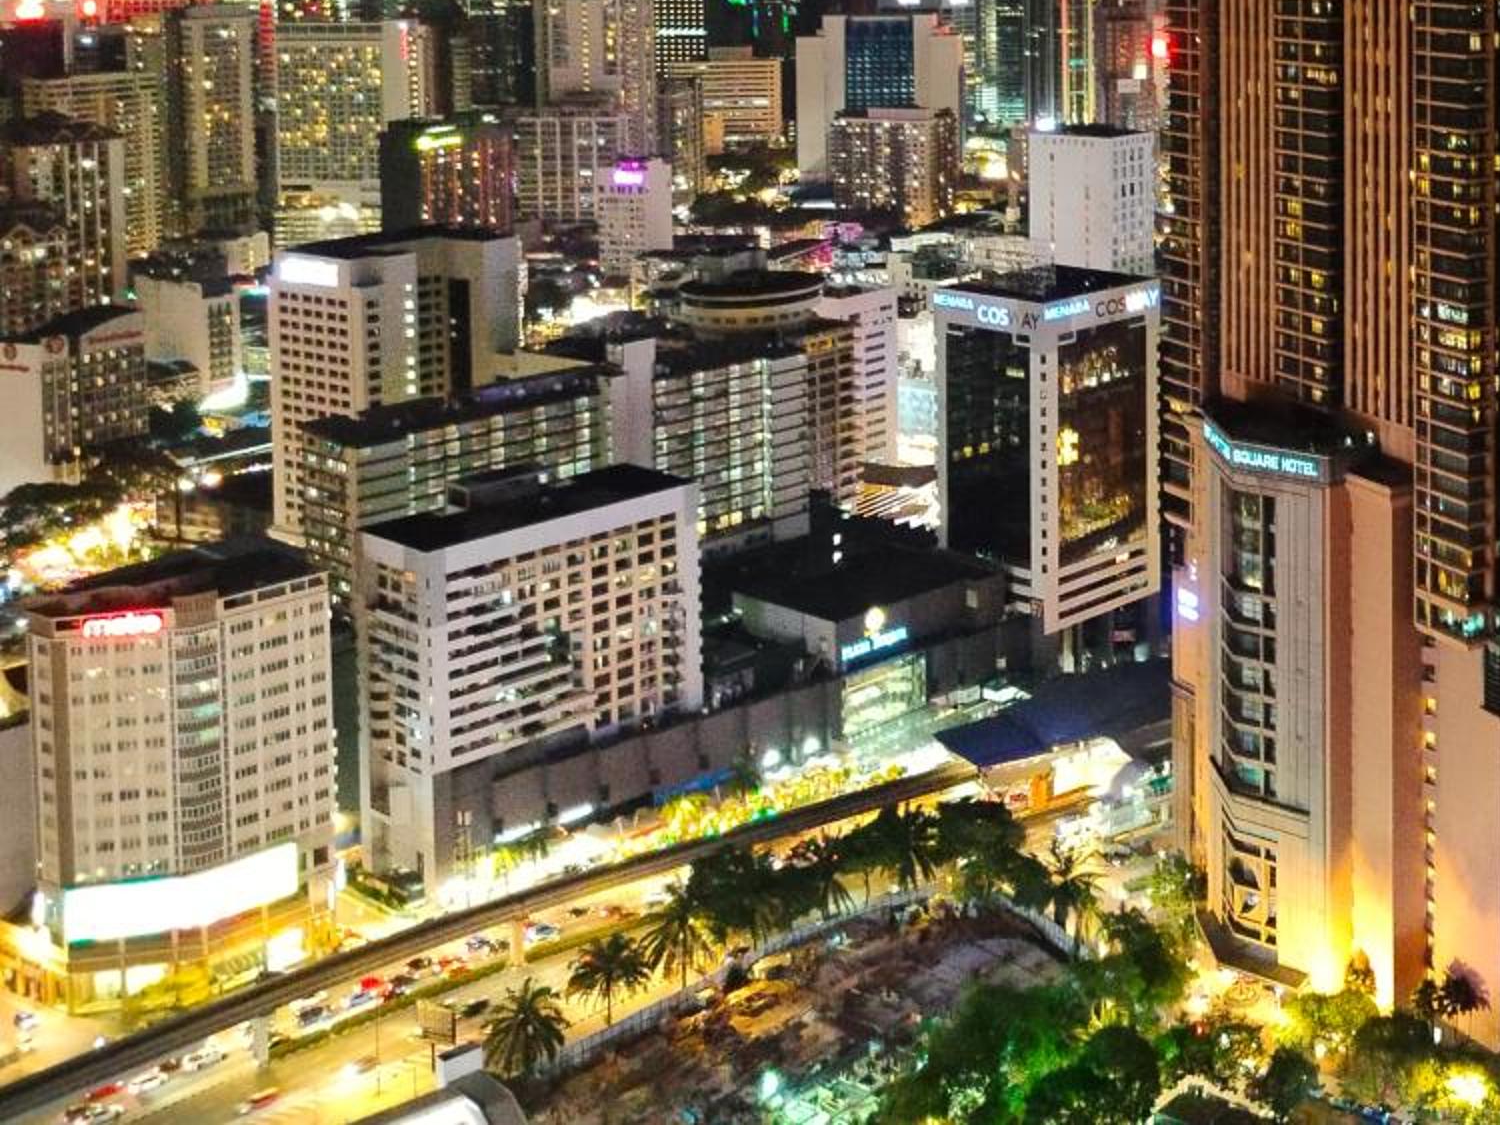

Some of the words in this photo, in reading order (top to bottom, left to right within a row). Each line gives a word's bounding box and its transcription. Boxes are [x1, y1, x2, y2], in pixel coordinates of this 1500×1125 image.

[933, 293, 975, 311] MENARA
[976, 306, 1041, 331] COSAY
[1043, 299, 1091, 321] MENARA
[1233, 450, 1279, 470] SQUARE
[1281, 458, 1318, 476] HOTEL
